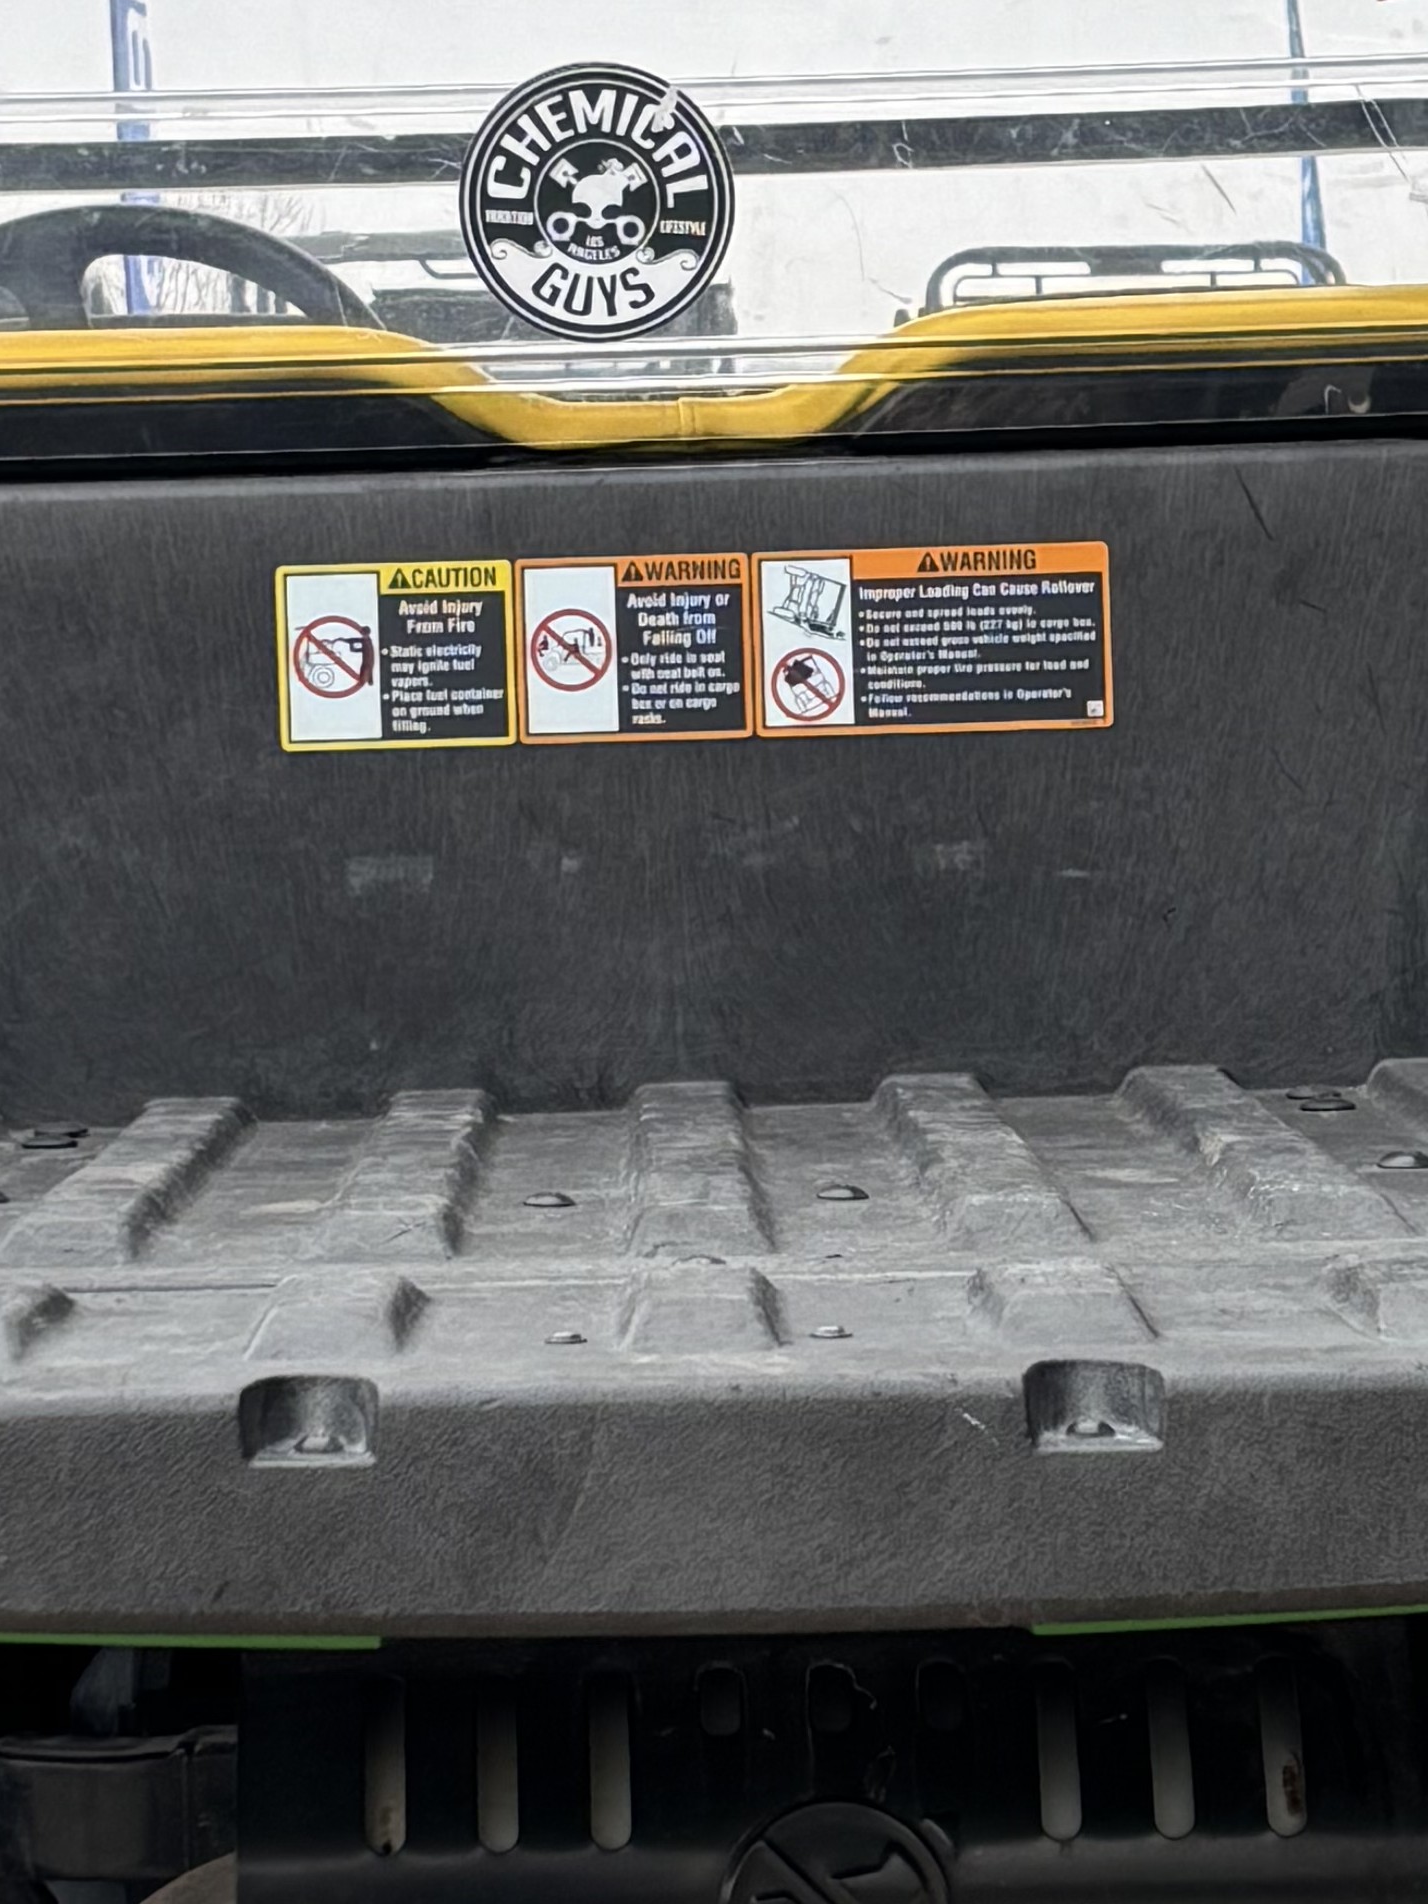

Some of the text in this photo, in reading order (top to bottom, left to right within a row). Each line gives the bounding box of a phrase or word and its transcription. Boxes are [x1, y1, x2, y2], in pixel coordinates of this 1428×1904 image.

[486, 88, 710, 209] CHEMICAL
[531, 262, 656, 317] GUYS
[939, 549, 1037, 572] WARNING
[412, 566, 496, 588] CAUTION
[645, 558, 741, 581] WARNING
[859, 579, 1095, 603] Improper Loading Can Cause Rollover
[398, 599, 483, 616] Avoid Injury
[627, 592, 731, 609] Avoid Injury or
[637, 610, 716, 627] Death from
[866, 609, 902, 620] Secure
[905, 608, 924, 618] and
[927, 606, 963, 619] spread
[407, 616, 476, 634] From Fire
[883, 622, 900, 633] not
[904, 621, 940, 633] exceed
[979, 618, 1003, 631] (227
[1040, 618, 1069, 629] cargo
[642, 628, 717, 648] Falling Off
[883, 637, 900, 647] not
[902, 636, 939, 647] exceed
[941, 636, 970, 647] gross
[972, 633, 1009, 644] vehicle
[1012, 632, 1046, 645] weight
[1049, 630, 1096, 644] specified
[390, 643, 482, 658] Static electricity
[631, 650, 725, 667] Only ride in seat
[391, 658, 475, 674] may ignite fuel
[631, 667, 655, 680] with
[657, 667, 681, 679] seat
[683, 666, 706, 678] belt
[867, 658, 1090, 676] Maintain proper tire pressure for load and
[392, 686, 504, 702] Place fuel container
[631, 681, 740, 695] Do not ride in cargo
[632, 697, 717, 710] box or on cargo
[868, 693, 904, 704] Follow
[906, 690, 1000, 703] recommendations
[392, 702, 484, 719] on ground when
